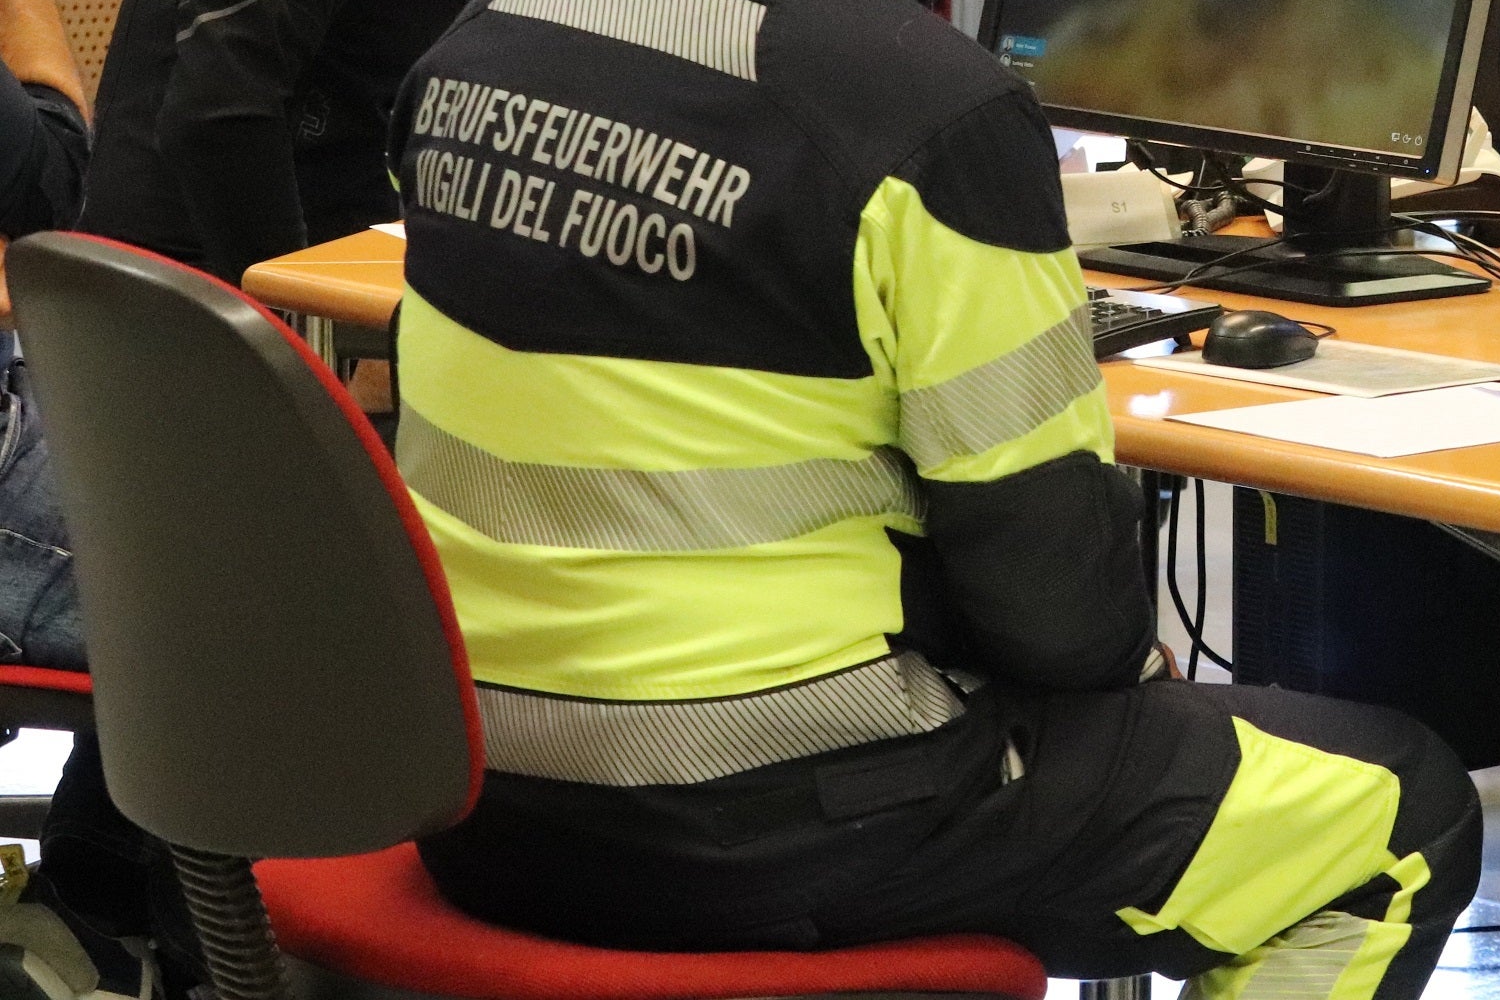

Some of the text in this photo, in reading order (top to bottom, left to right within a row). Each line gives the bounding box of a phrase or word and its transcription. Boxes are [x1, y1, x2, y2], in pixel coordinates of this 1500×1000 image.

[414, 77, 751, 228] BERUFSFEUERWEHR
[416, 148, 697, 282] VIGILI DEL FUOCO
[1111, 201, 1127, 214] S1
